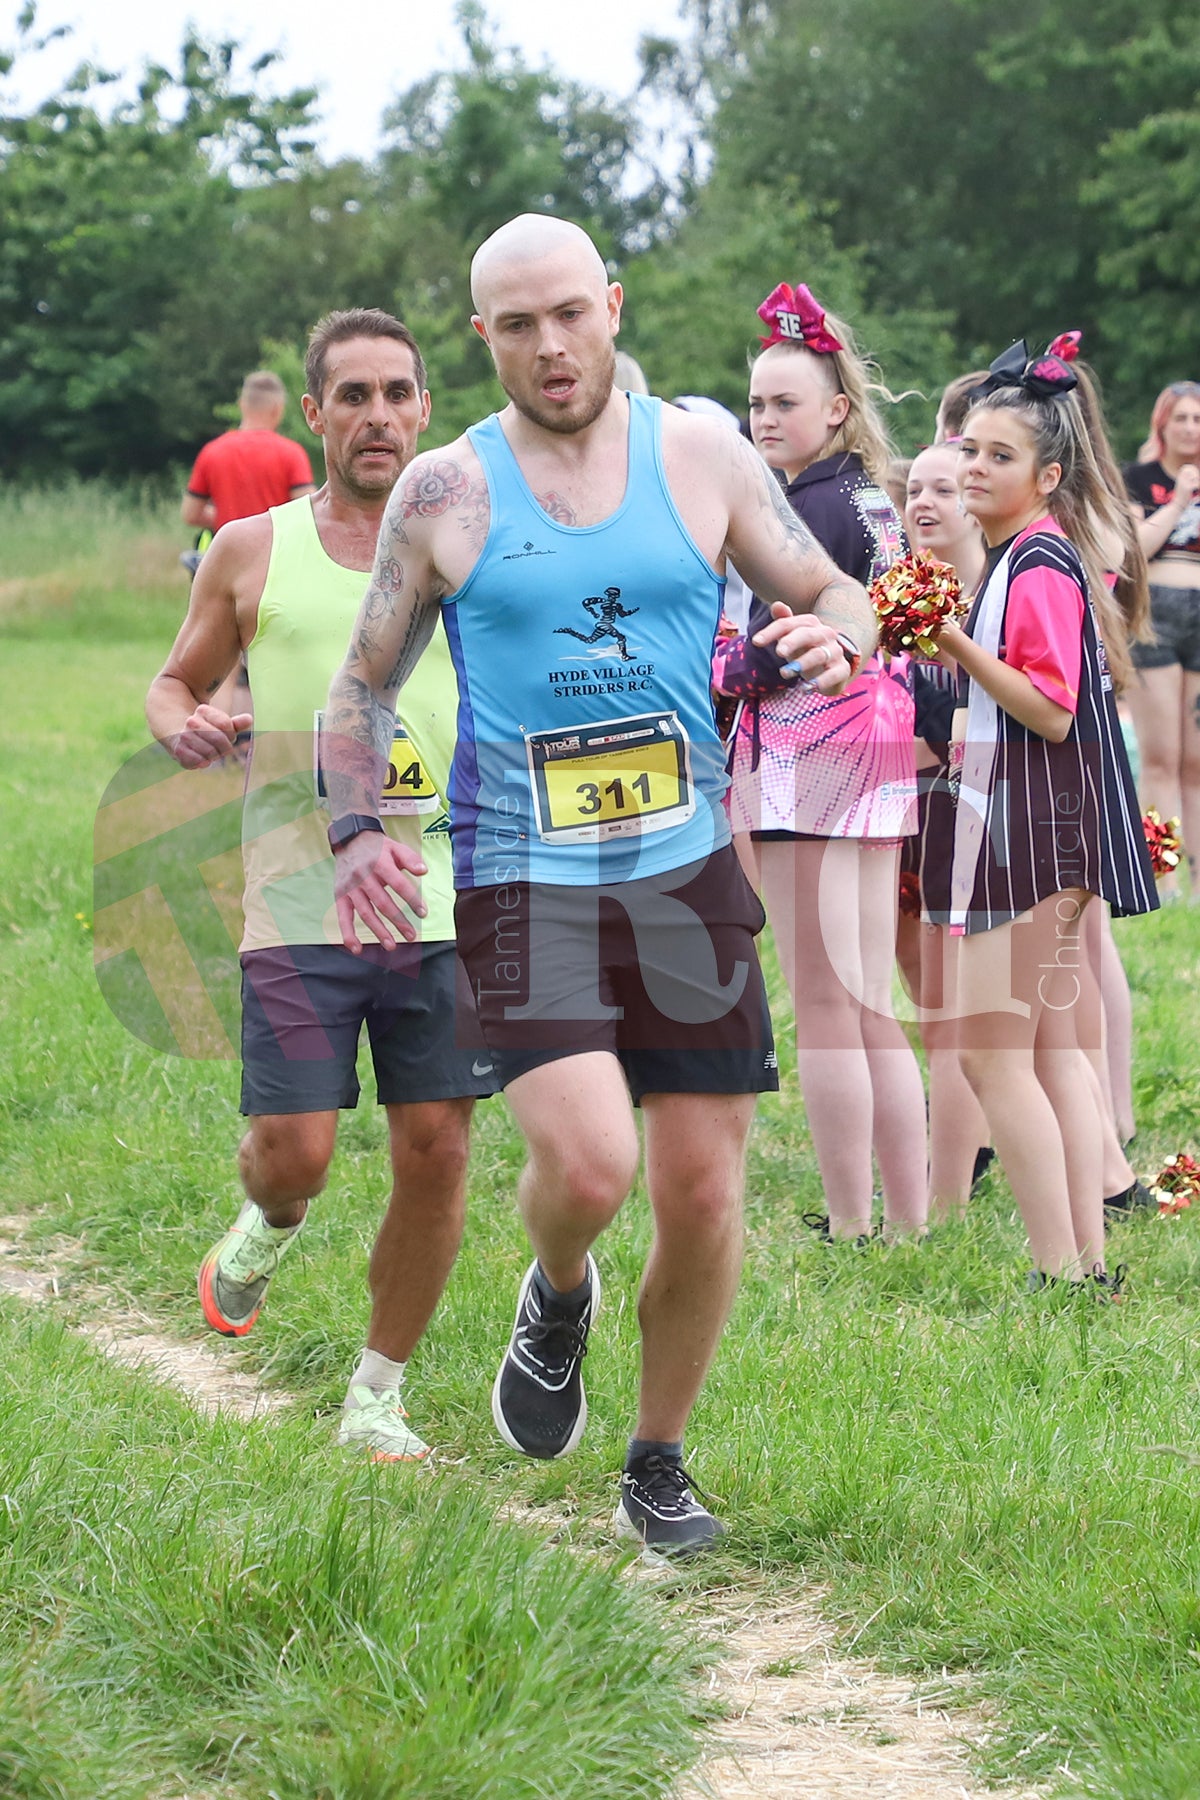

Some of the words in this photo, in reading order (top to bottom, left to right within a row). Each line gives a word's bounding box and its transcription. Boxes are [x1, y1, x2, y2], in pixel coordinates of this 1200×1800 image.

[502, 549, 558, 561] RONHILL
[548, 669, 590, 683] HYDE
[592, 664, 655, 680] VILLAGE
[553, 681, 625, 698] STRIDERS
[627, 679, 653, 692] R.C.
[575, 772, 652, 815] 311
